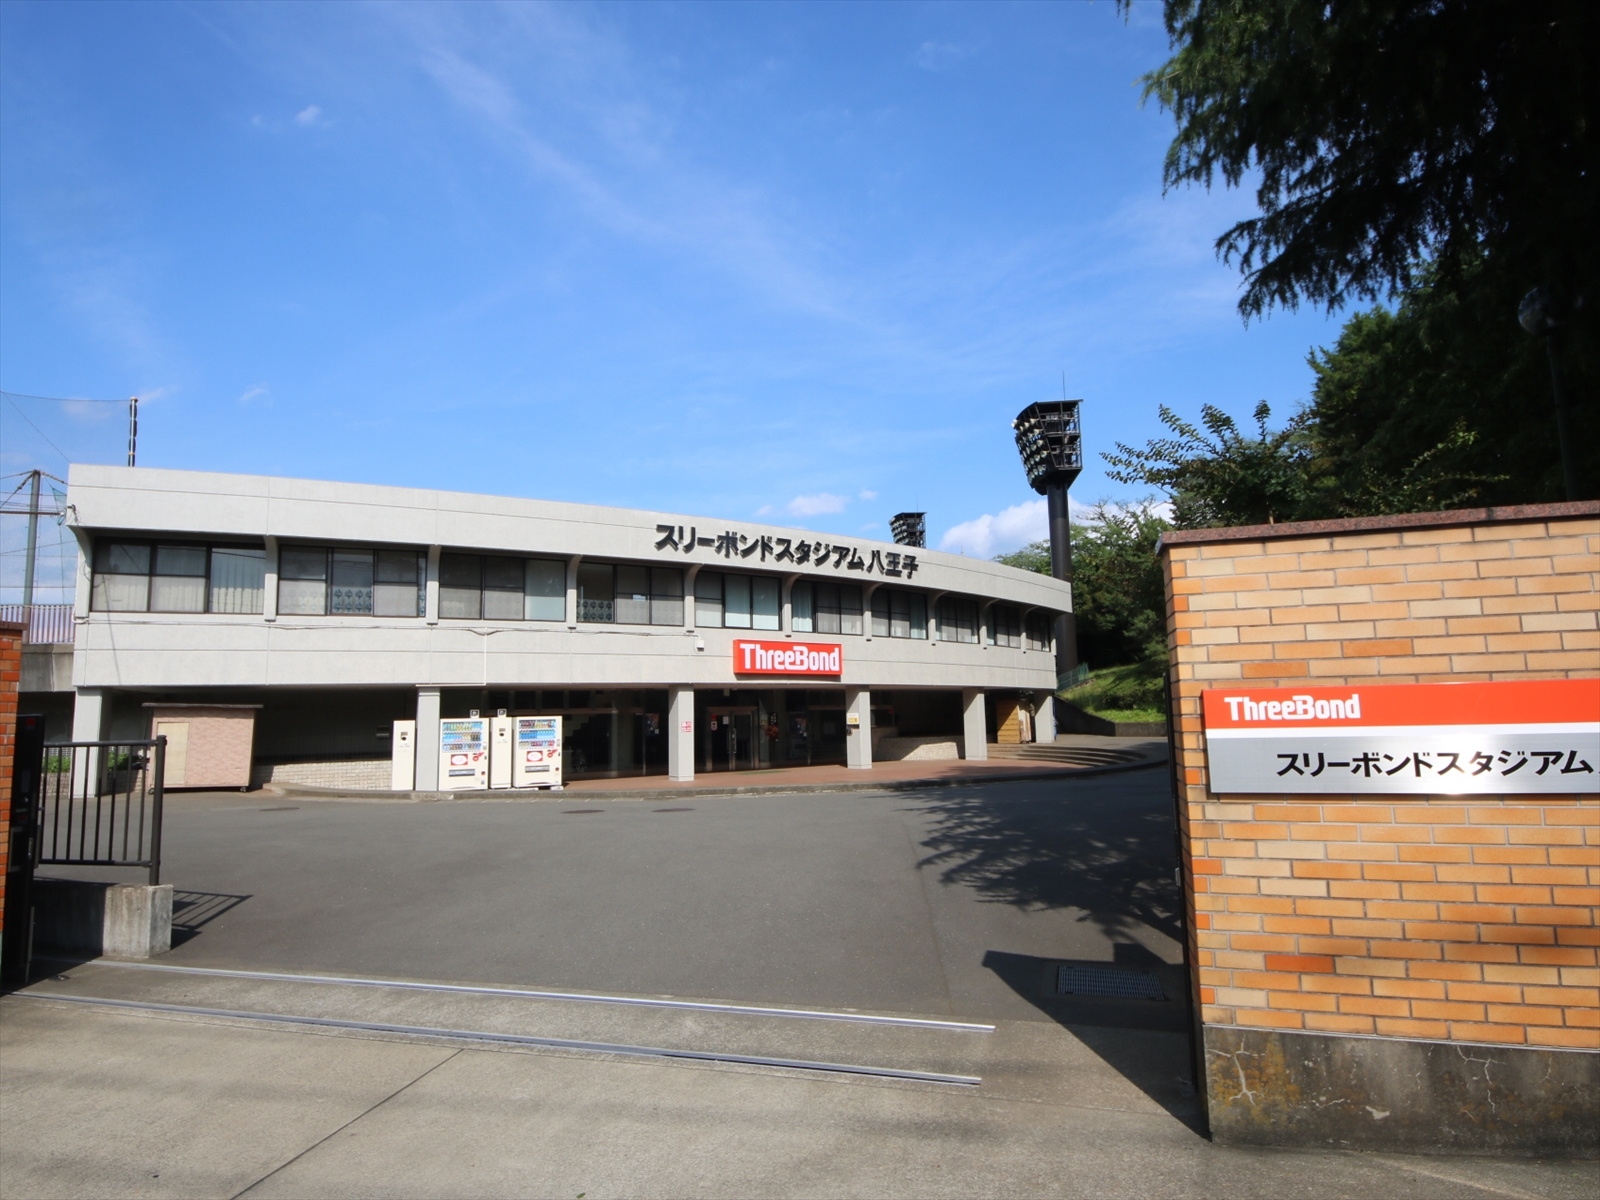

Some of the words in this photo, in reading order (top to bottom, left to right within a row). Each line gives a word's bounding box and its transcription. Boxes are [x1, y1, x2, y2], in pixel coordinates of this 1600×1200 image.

[654, 524, 919, 579] スリーボンドスタジアム八王子
[739, 643, 840, 672] ThreeBond
[1224, 694, 1361, 721] ThreeBond
[1276, 749, 1600, 778] スリーボンドスタジアム
